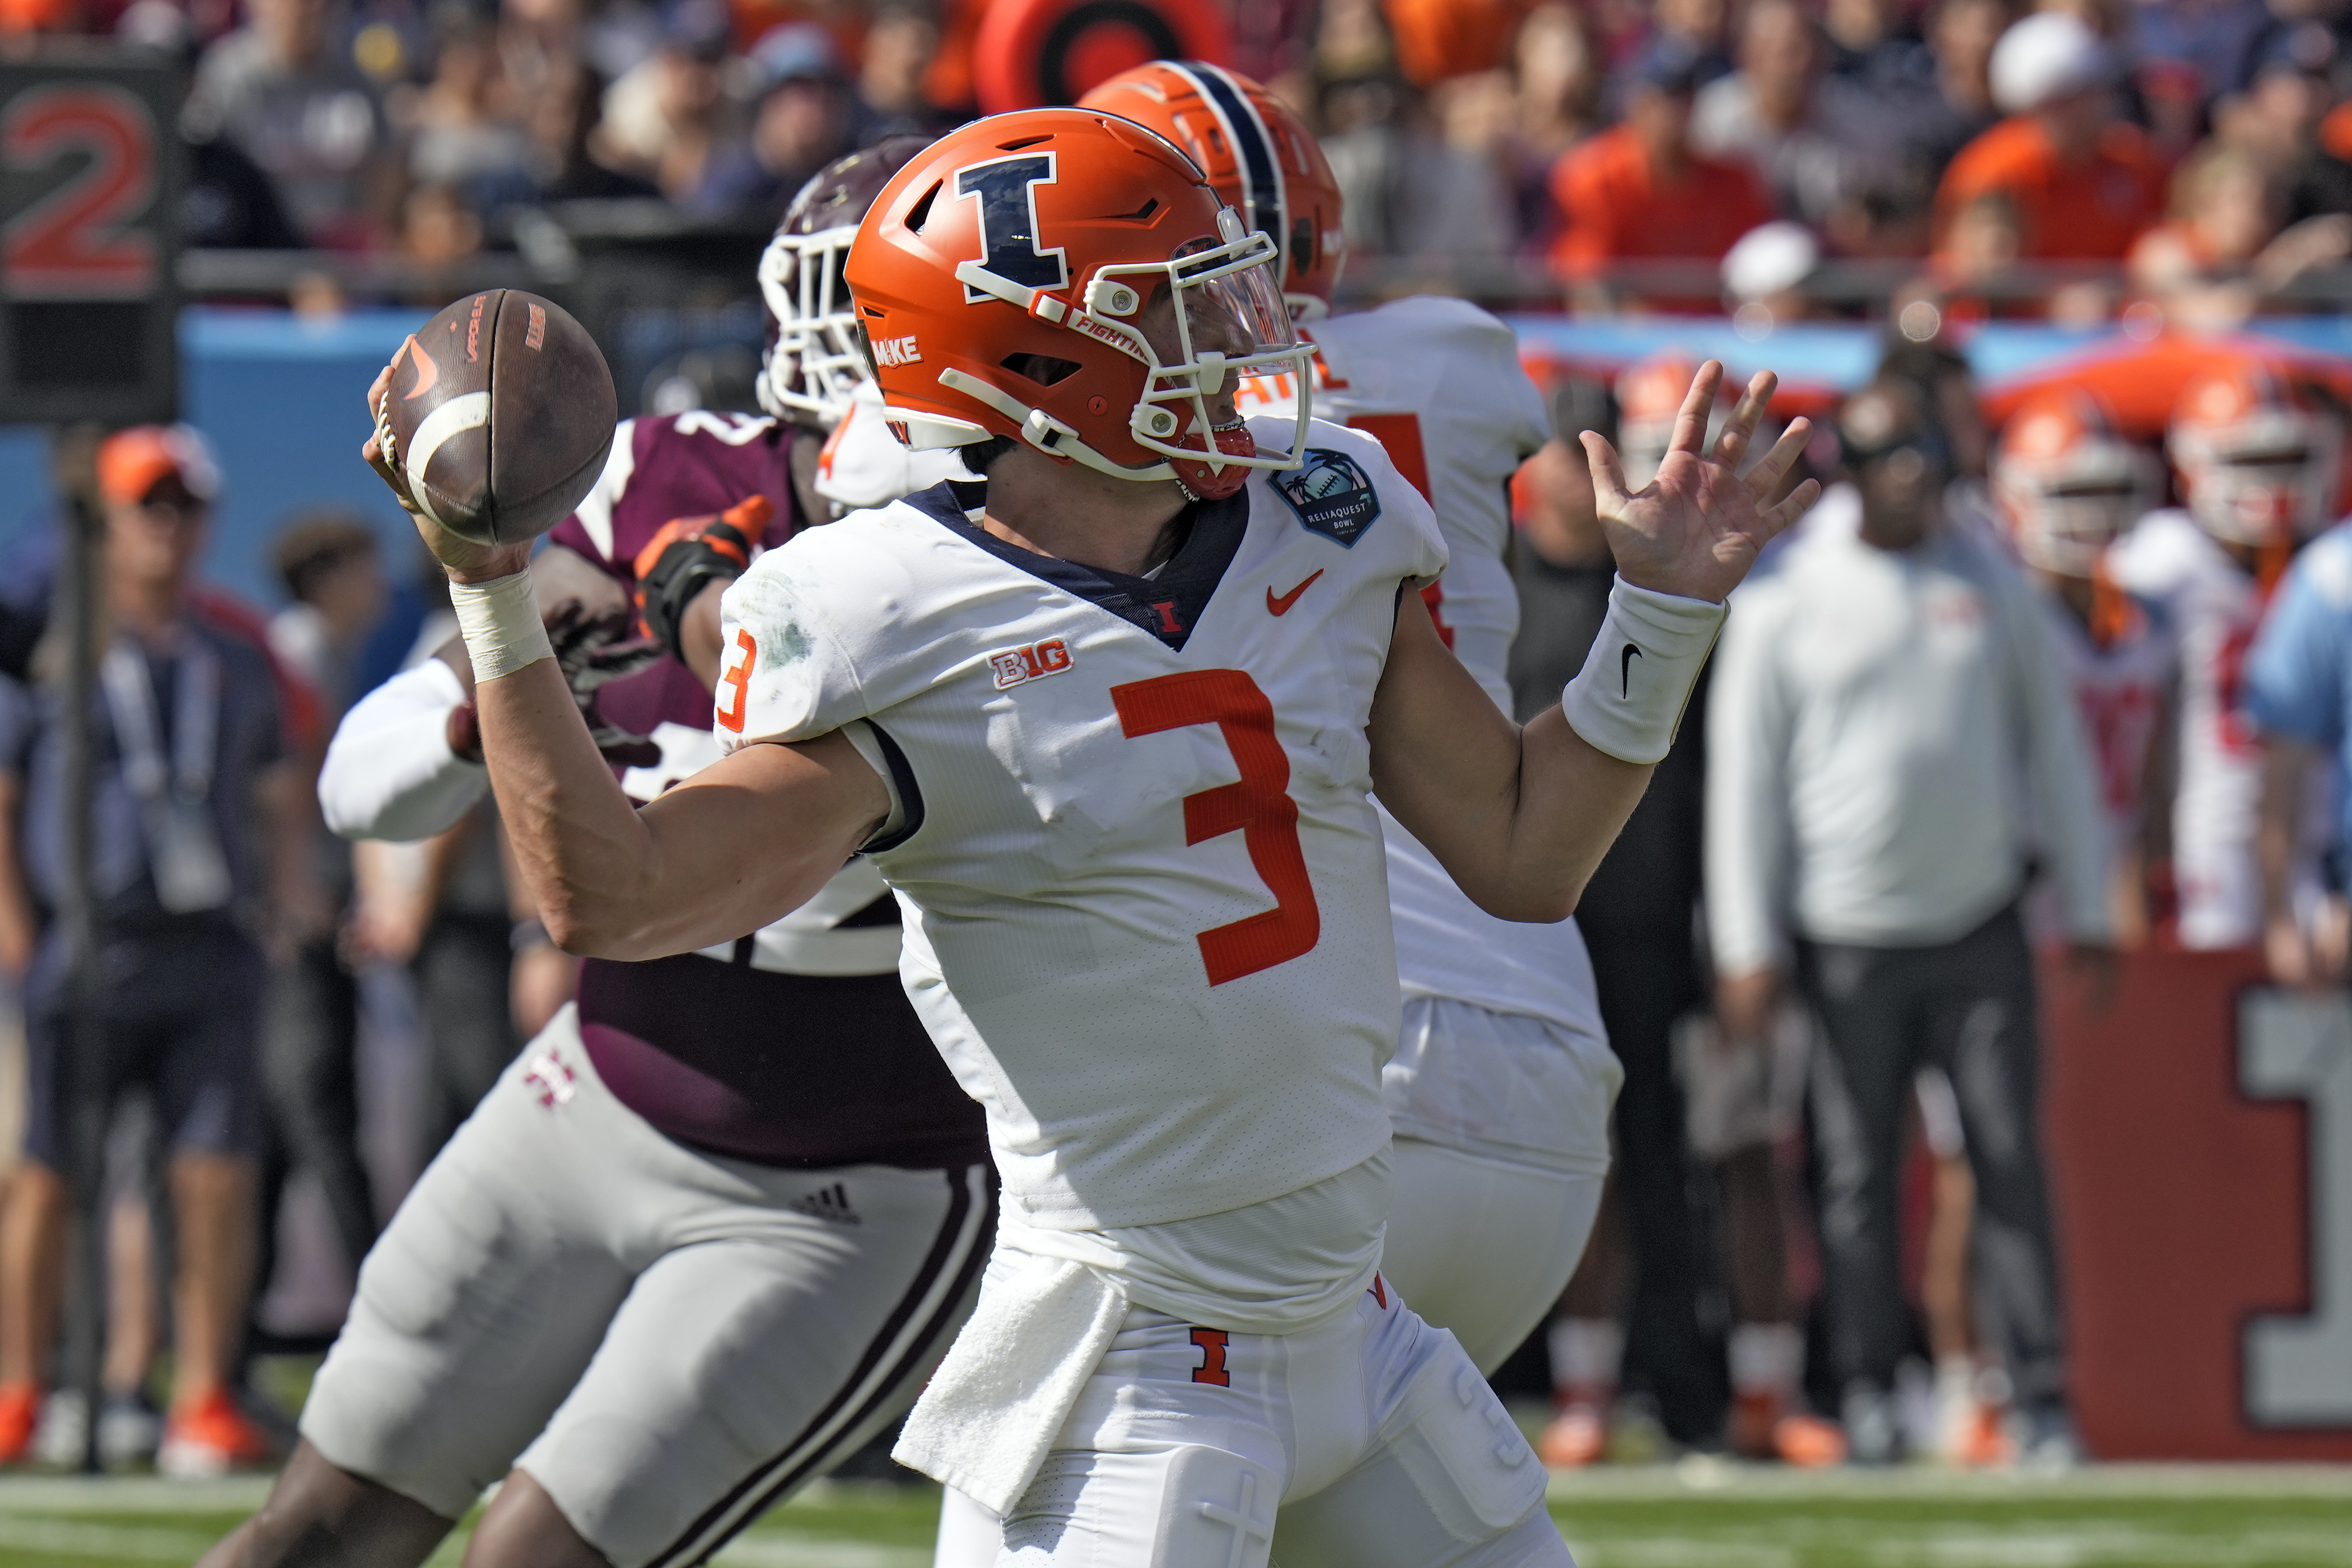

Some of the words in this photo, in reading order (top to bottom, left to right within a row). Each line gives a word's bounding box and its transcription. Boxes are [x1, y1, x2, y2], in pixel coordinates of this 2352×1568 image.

[3, 81, 160, 302] 2
[954, 151, 1070, 304] I
[467, 318, 481, 363] VAPOR
[1308, 502, 1366, 523] RELIAQUEST
[1333, 518, 1355, 529] BOWL
[1154, 601, 1182, 632] I
[717, 628, 757, 733] 3
[1110, 669, 1320, 987] 3
[1189, 1326, 1230, 1388] I
